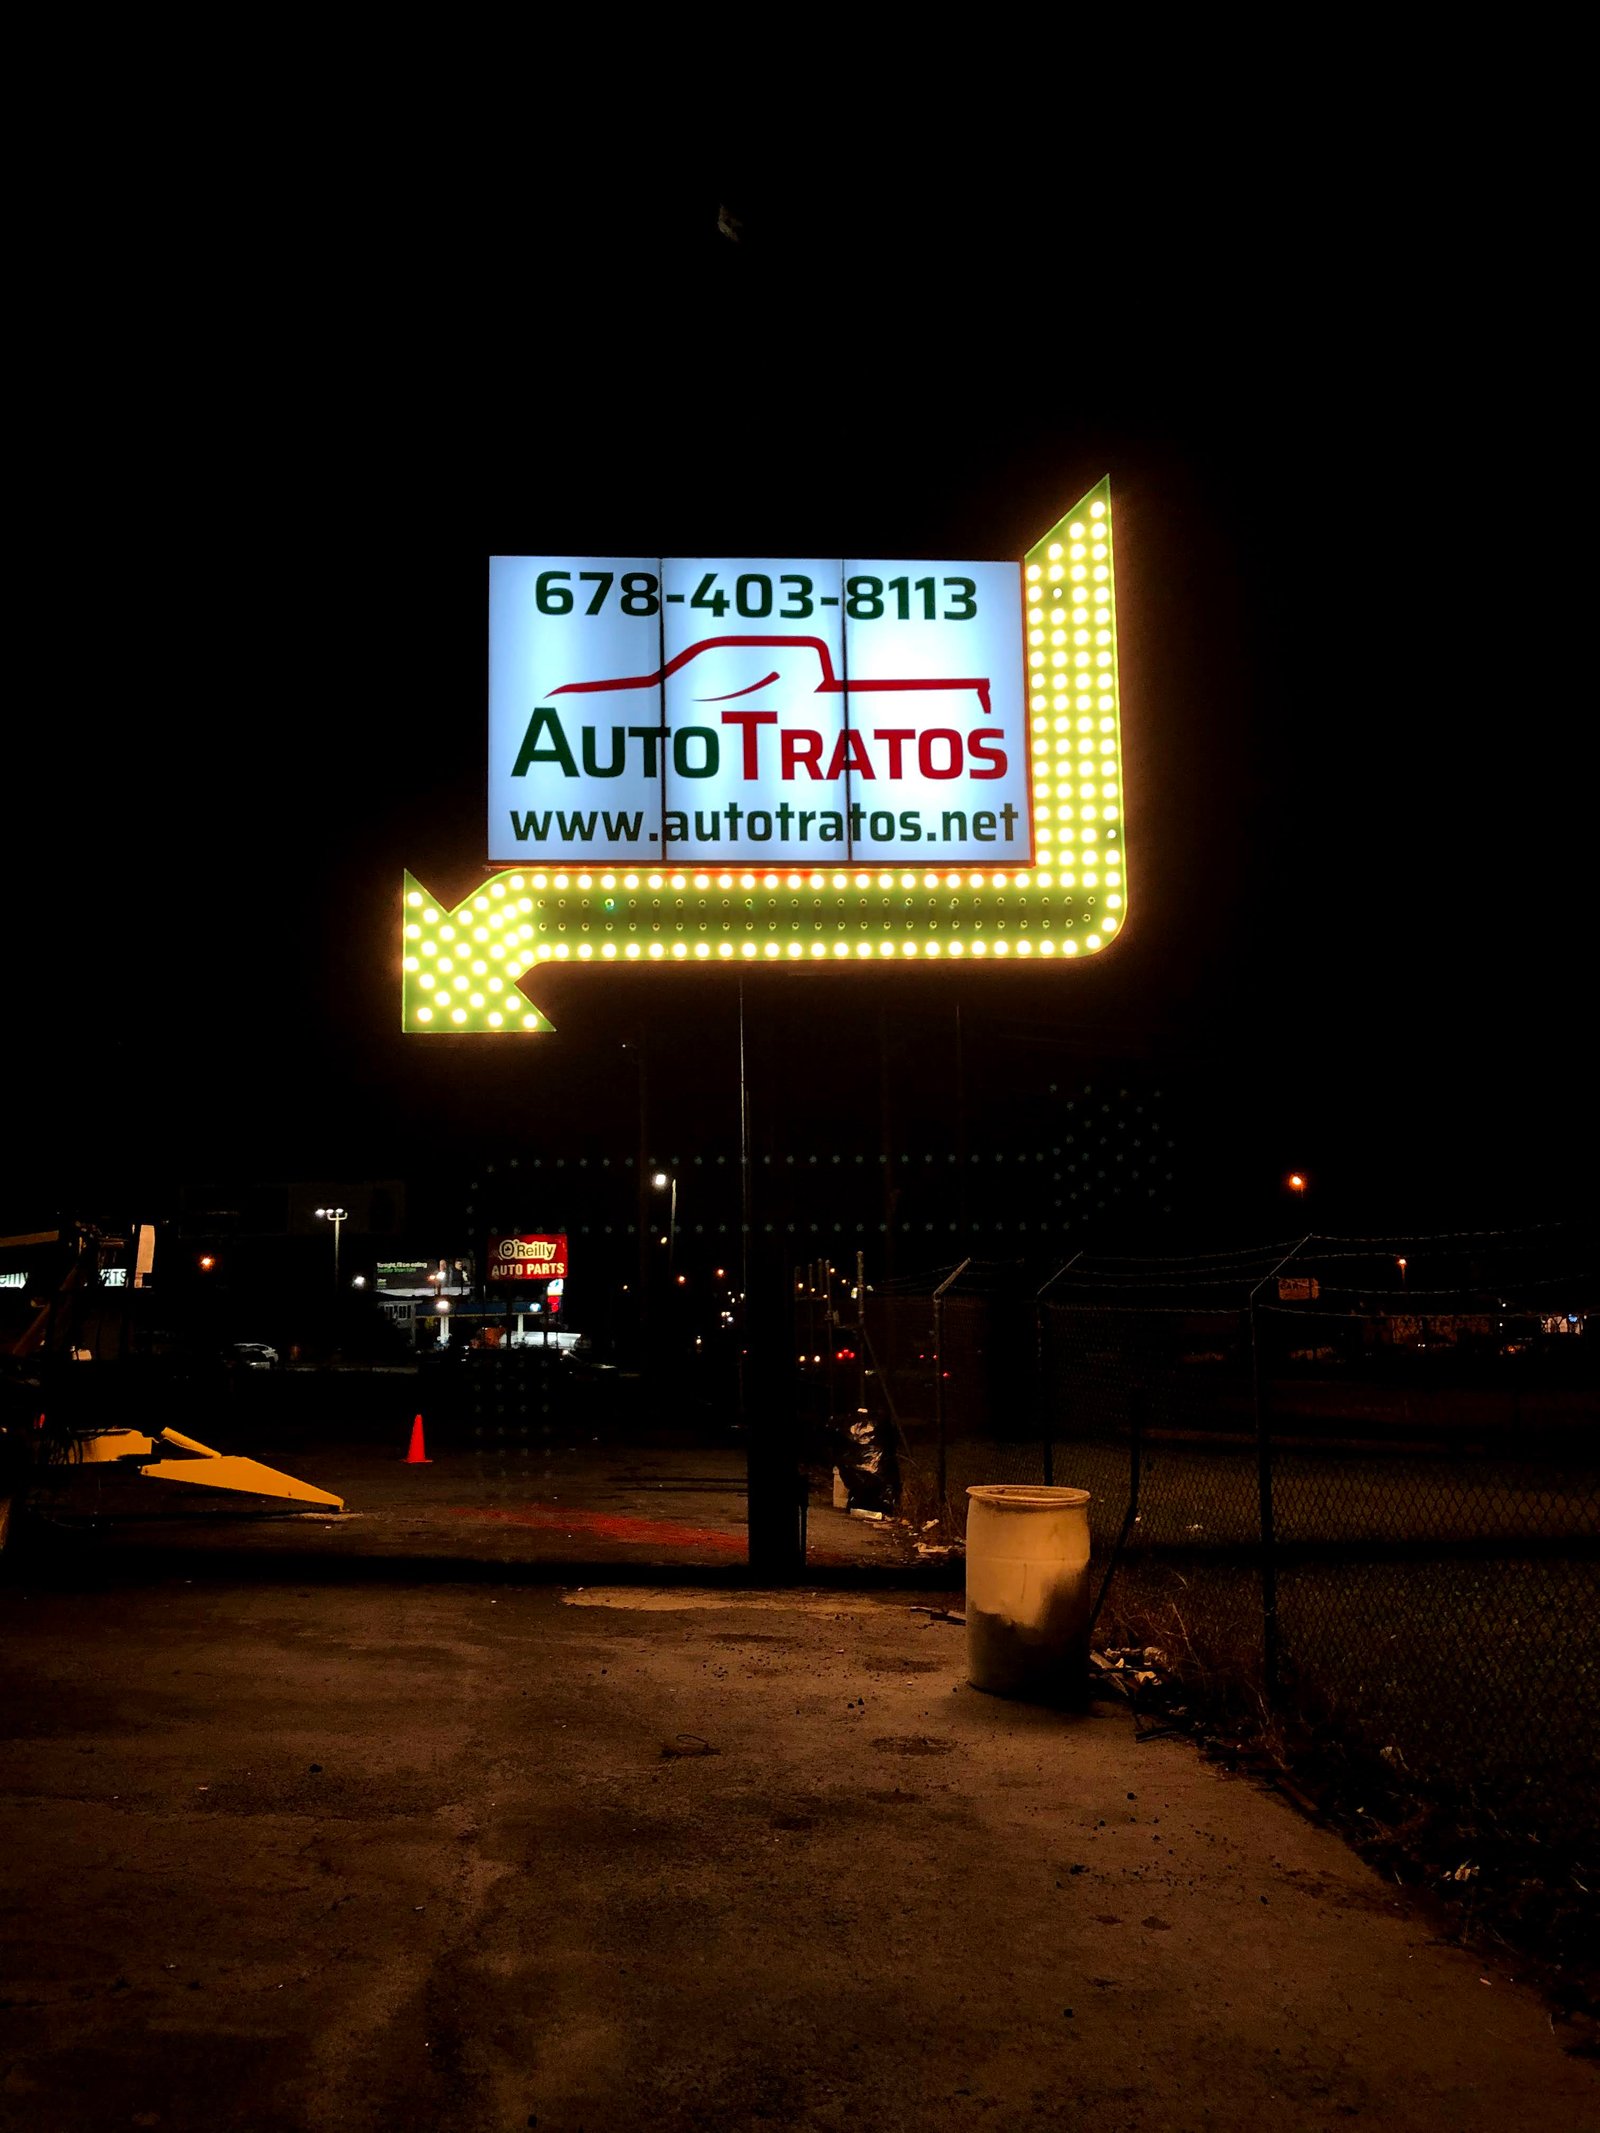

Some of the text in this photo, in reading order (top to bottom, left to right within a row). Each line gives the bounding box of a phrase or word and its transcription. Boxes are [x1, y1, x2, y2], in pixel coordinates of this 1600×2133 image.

[534, 570, 978, 621] 678-403-8113
[509, 802, 1019, 842] www.autotratos.net
[500, 1240, 555, 1259] O'Reilly
[491, 1262, 565, 1278] AUTO PARTS
